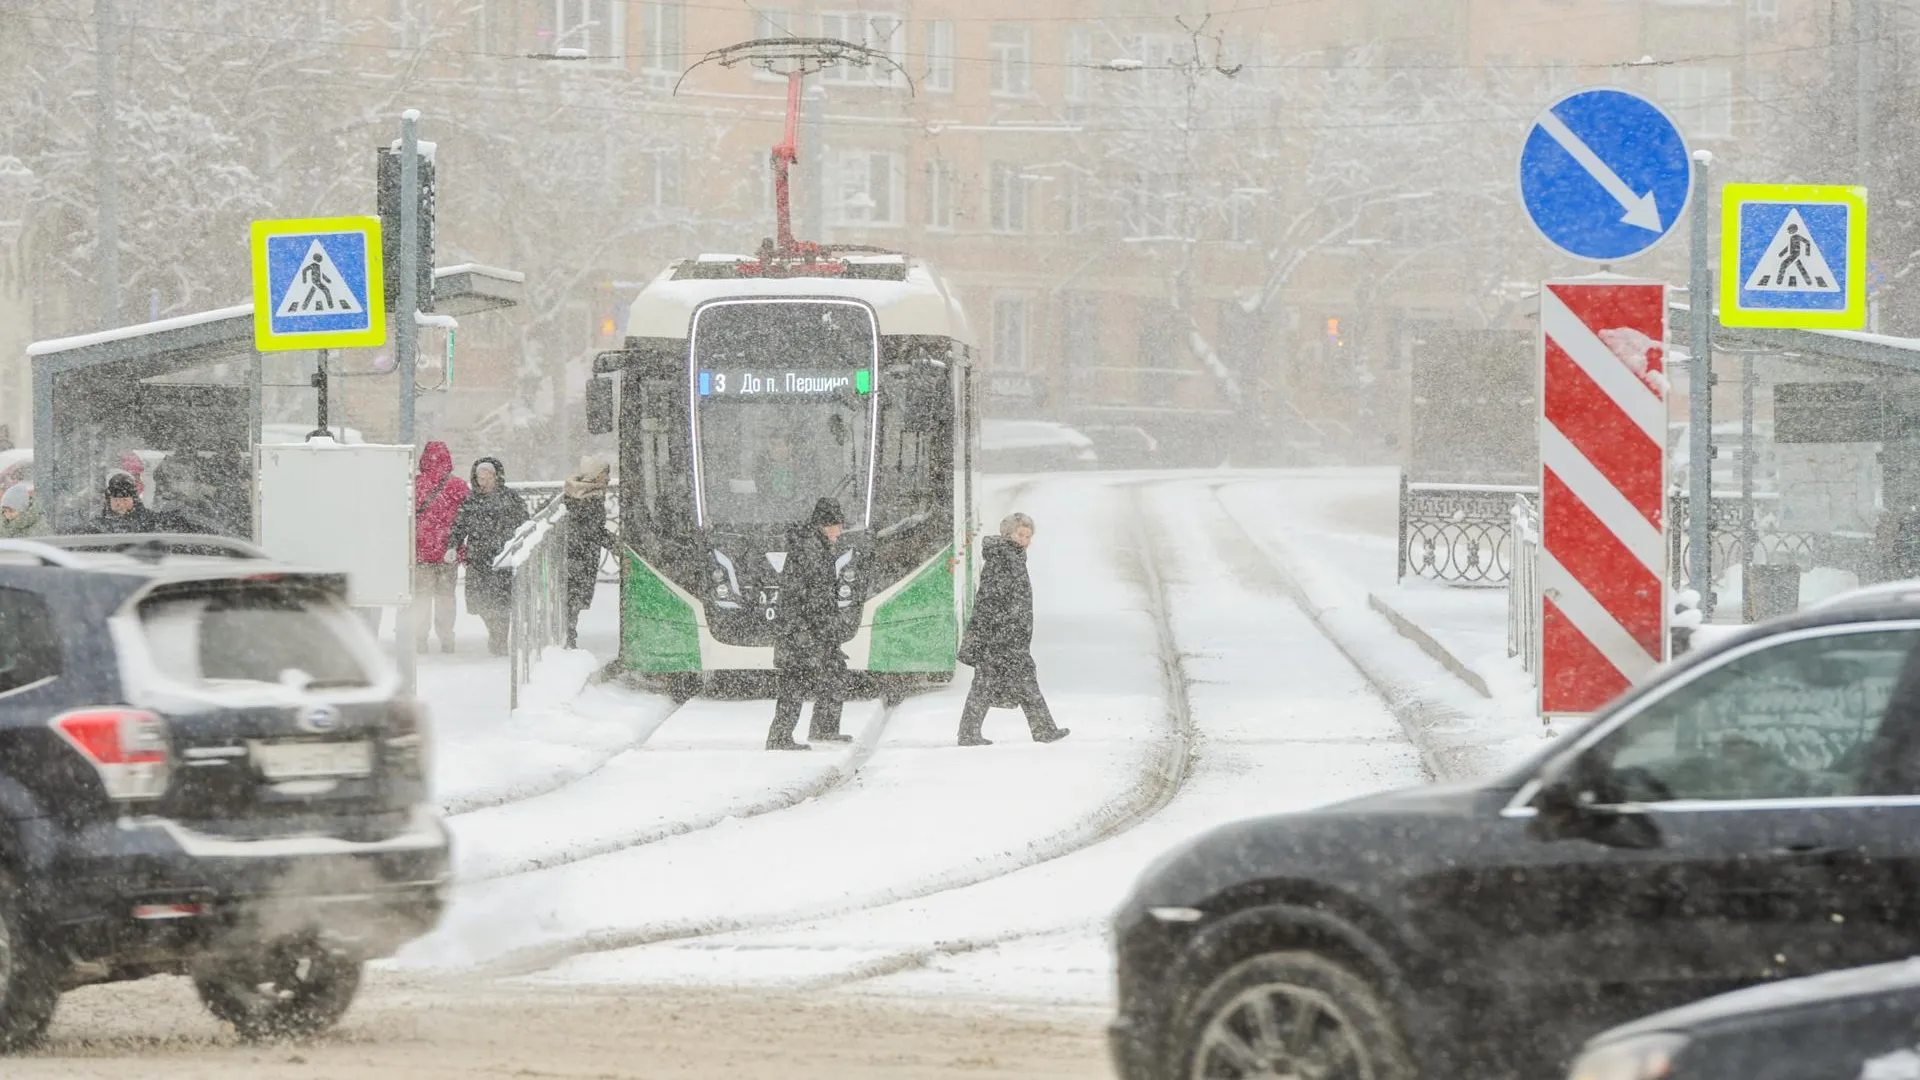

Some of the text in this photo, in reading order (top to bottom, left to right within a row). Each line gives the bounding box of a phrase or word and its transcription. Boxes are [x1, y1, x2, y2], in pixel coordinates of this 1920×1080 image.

[715, 373, 726, 392] 3
[740, 373, 761, 394] До
[766, 377, 779, 392] п.
